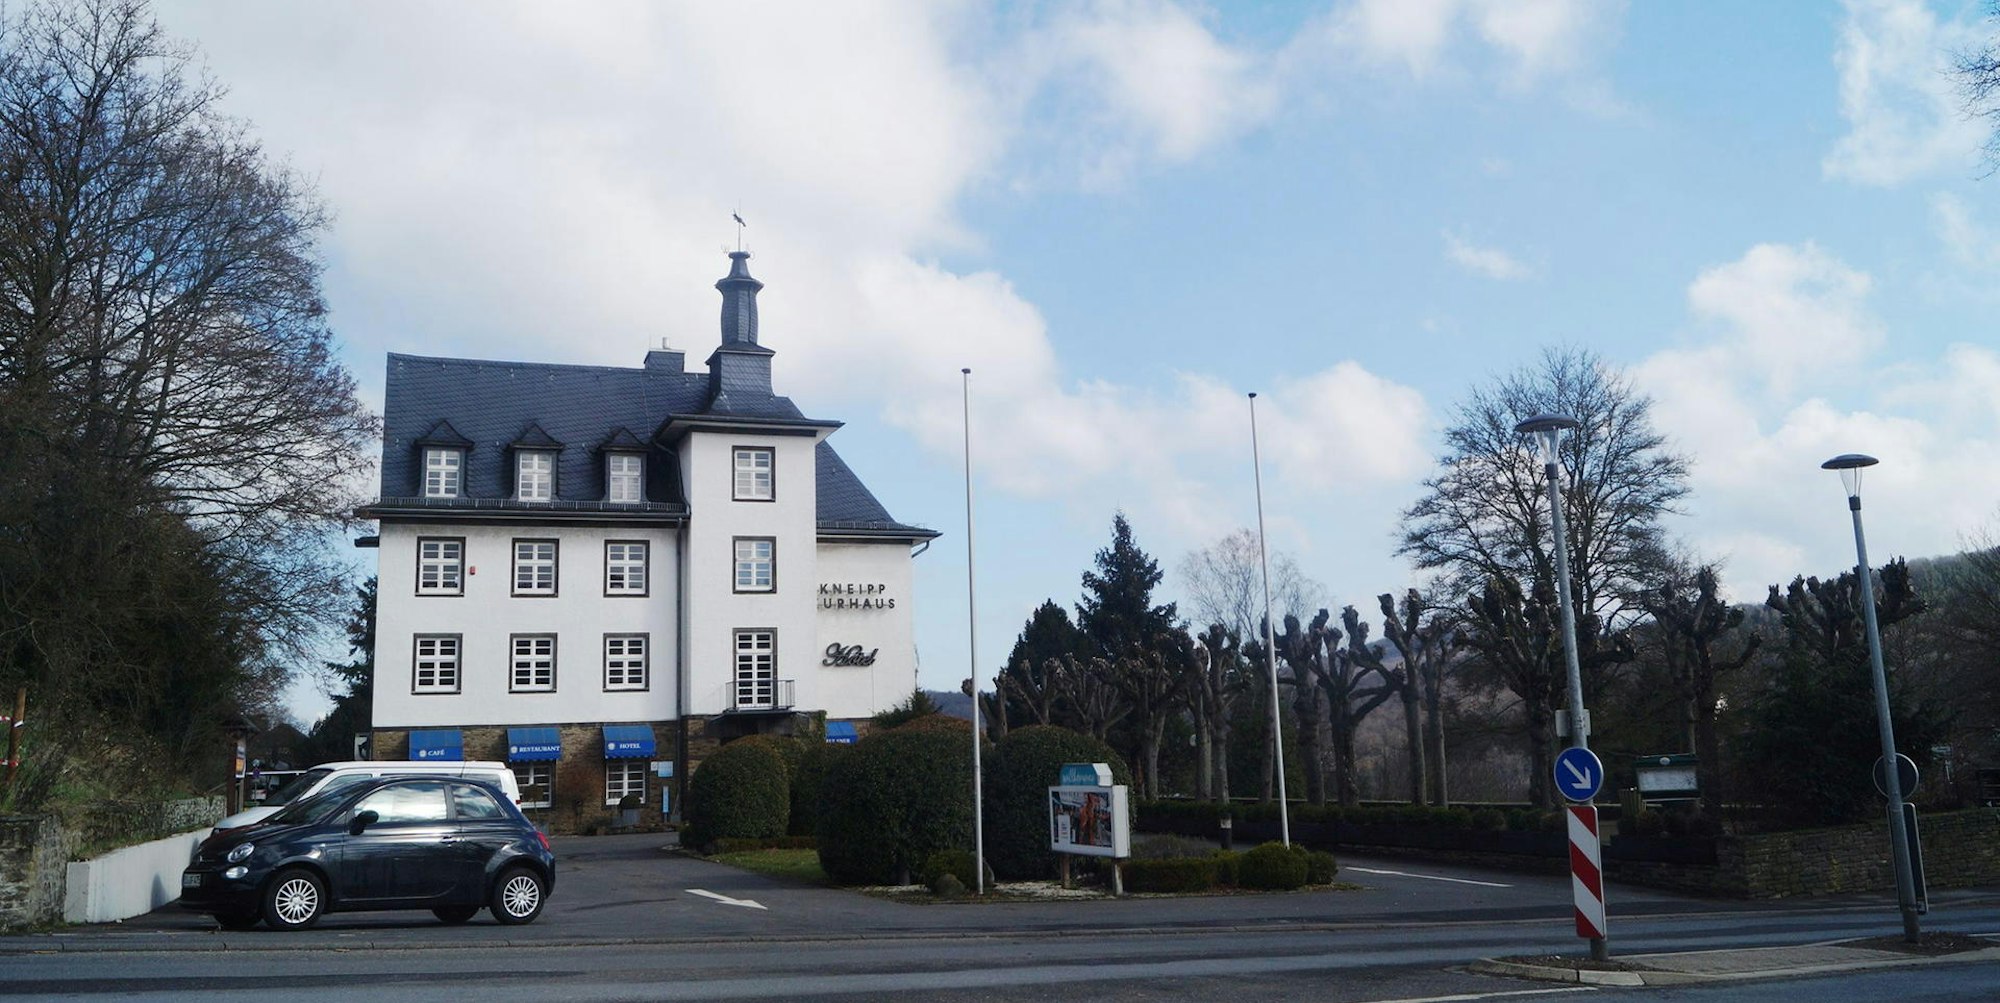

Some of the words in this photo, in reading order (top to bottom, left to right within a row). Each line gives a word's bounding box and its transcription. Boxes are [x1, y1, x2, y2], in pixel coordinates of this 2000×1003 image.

[820, 583, 886, 595] KNEIPP
[817, 598, 896, 609] URHAUS
[822, 642, 879, 667] Hotel
[428, 748, 445, 756] CAFÉ
[519, 745, 560, 753] RESTAURANT
